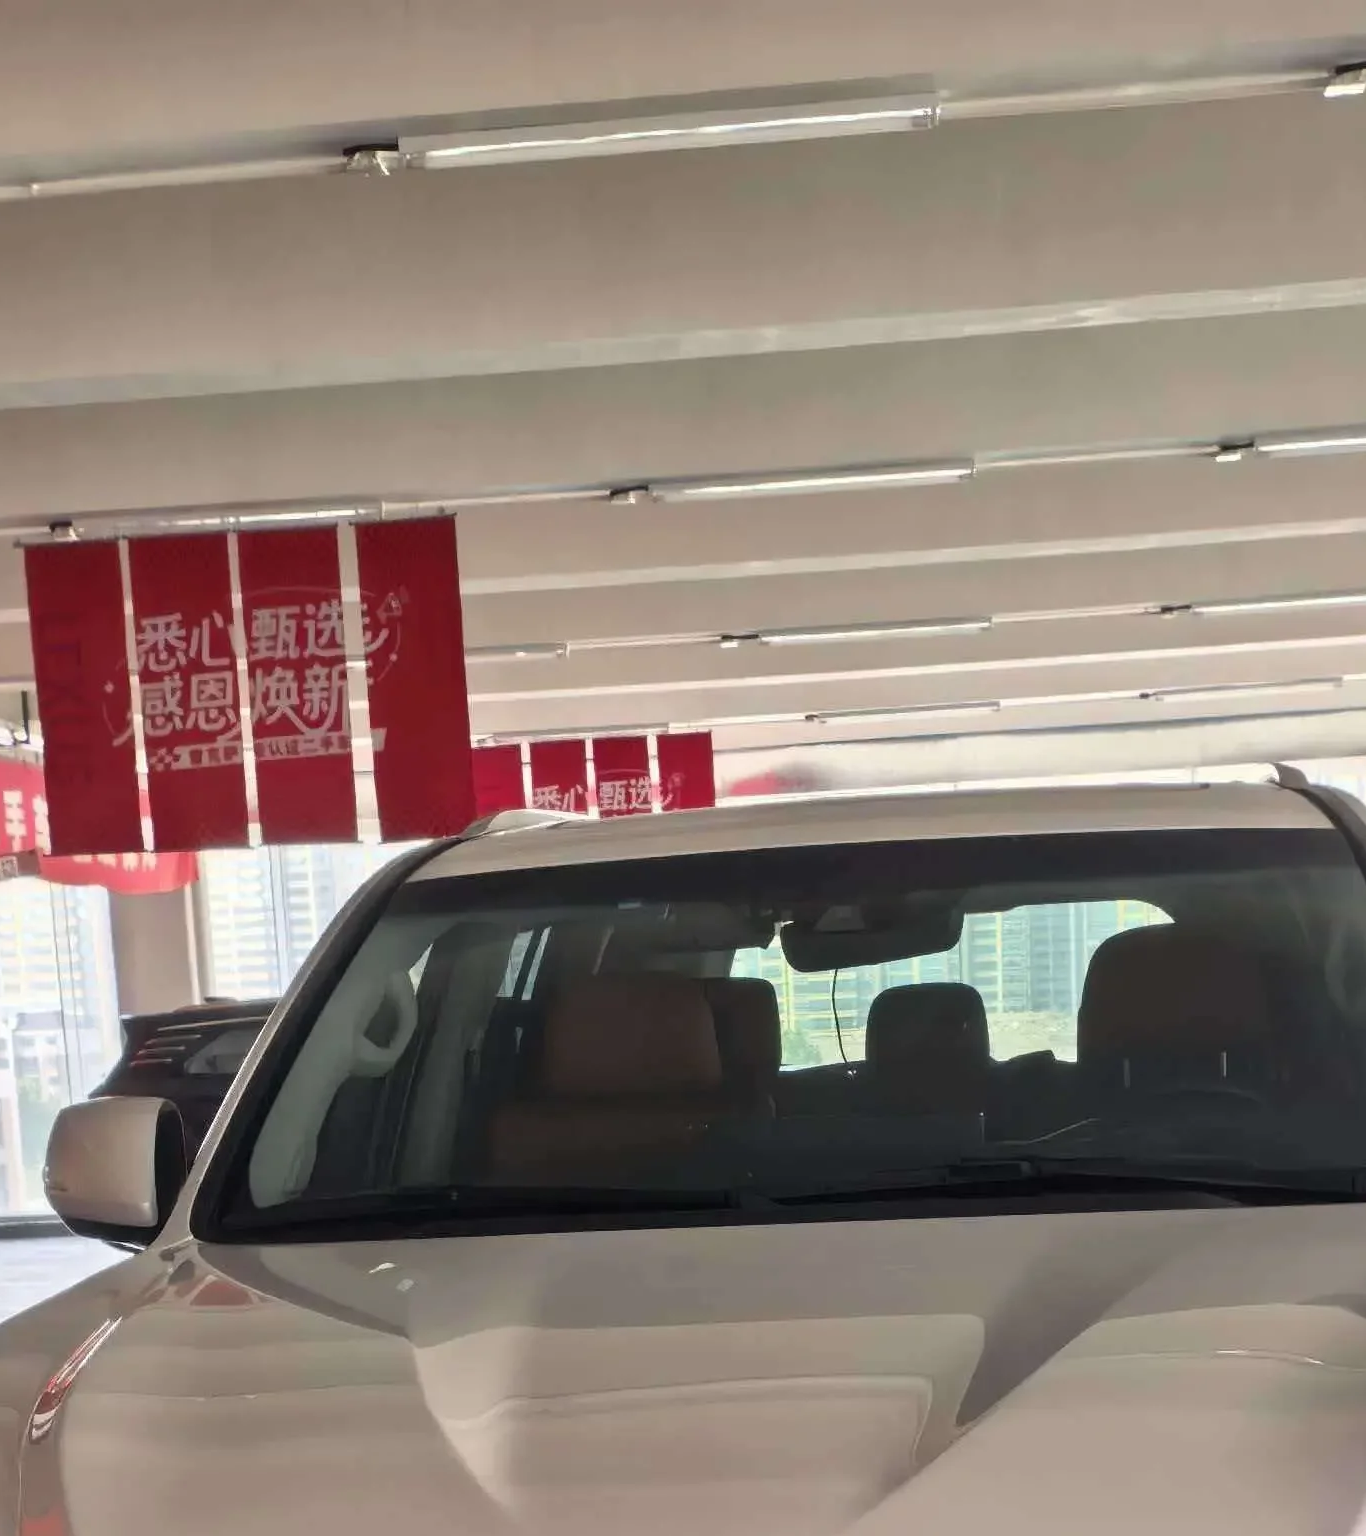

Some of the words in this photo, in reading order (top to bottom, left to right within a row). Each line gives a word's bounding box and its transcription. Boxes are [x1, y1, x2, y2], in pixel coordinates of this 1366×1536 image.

[137, 598, 390, 673] 悉心甄选
[112, 661, 374, 747] 感恩焕新
